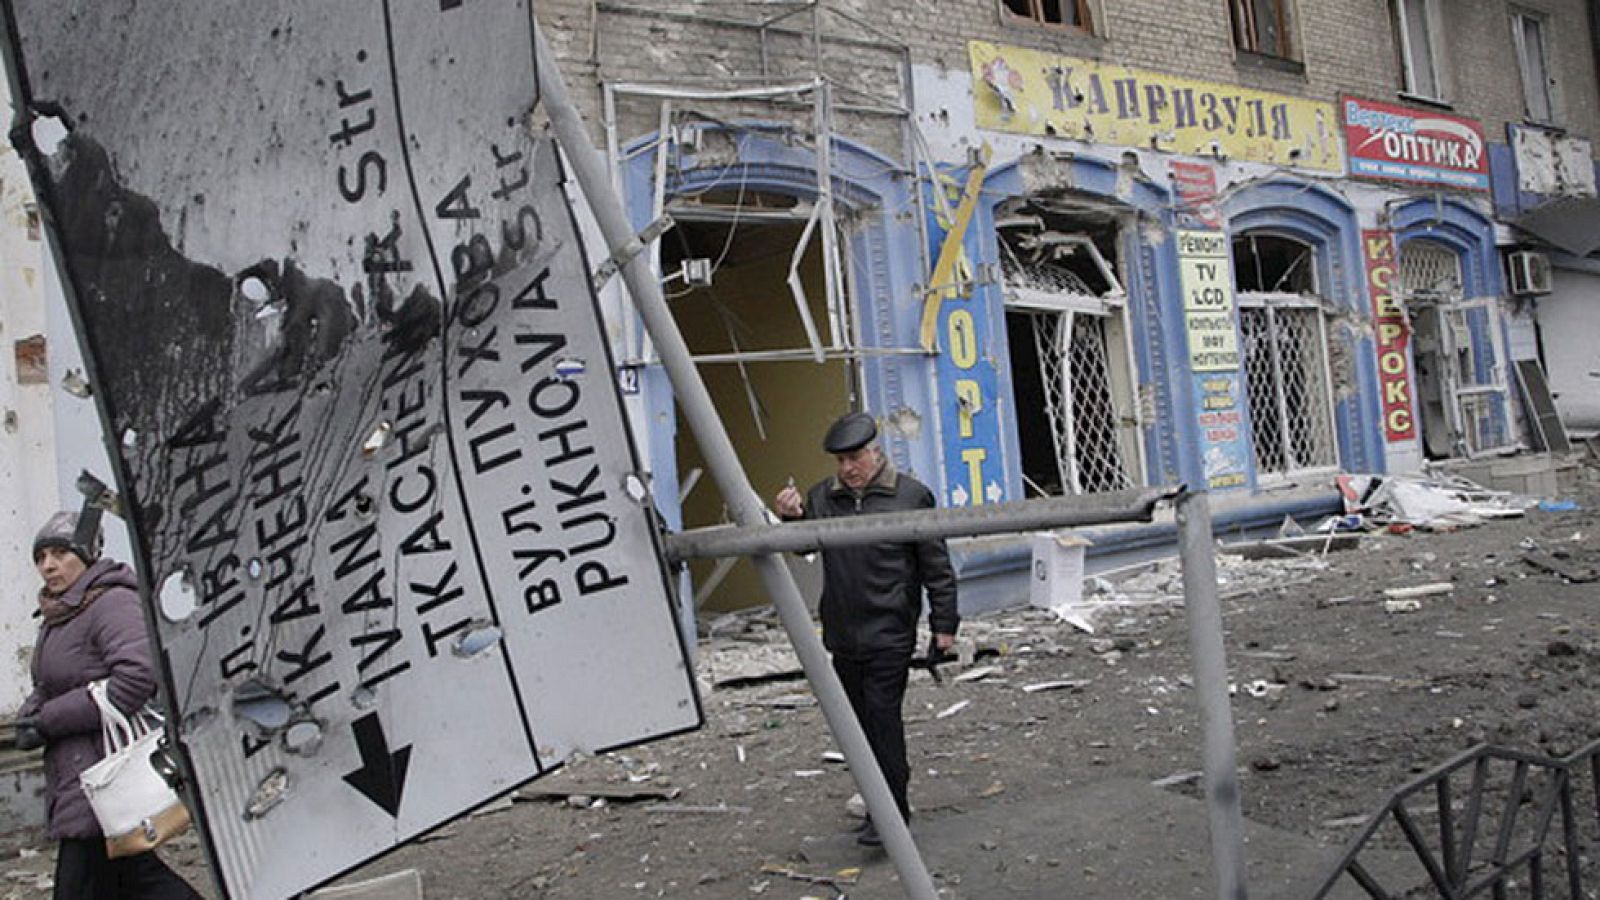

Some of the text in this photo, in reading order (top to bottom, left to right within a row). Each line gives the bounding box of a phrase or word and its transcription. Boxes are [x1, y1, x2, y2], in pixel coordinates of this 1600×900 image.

[330, 49, 388, 203] Str.
[1046, 66, 1292, 140] КАПРИЗУЛЯ
[1384, 131, 1479, 169] ОПТИКА
[436, 174, 522, 475] ПУХОВА
[1191, 288, 1224, 305] LCD
[1194, 263, 1216, 280] TV
[1367, 239, 1412, 433] КСЕРОКС
[491, 116, 629, 596] PUKHOVA Str.
[326, 477, 411, 689] IVANA
